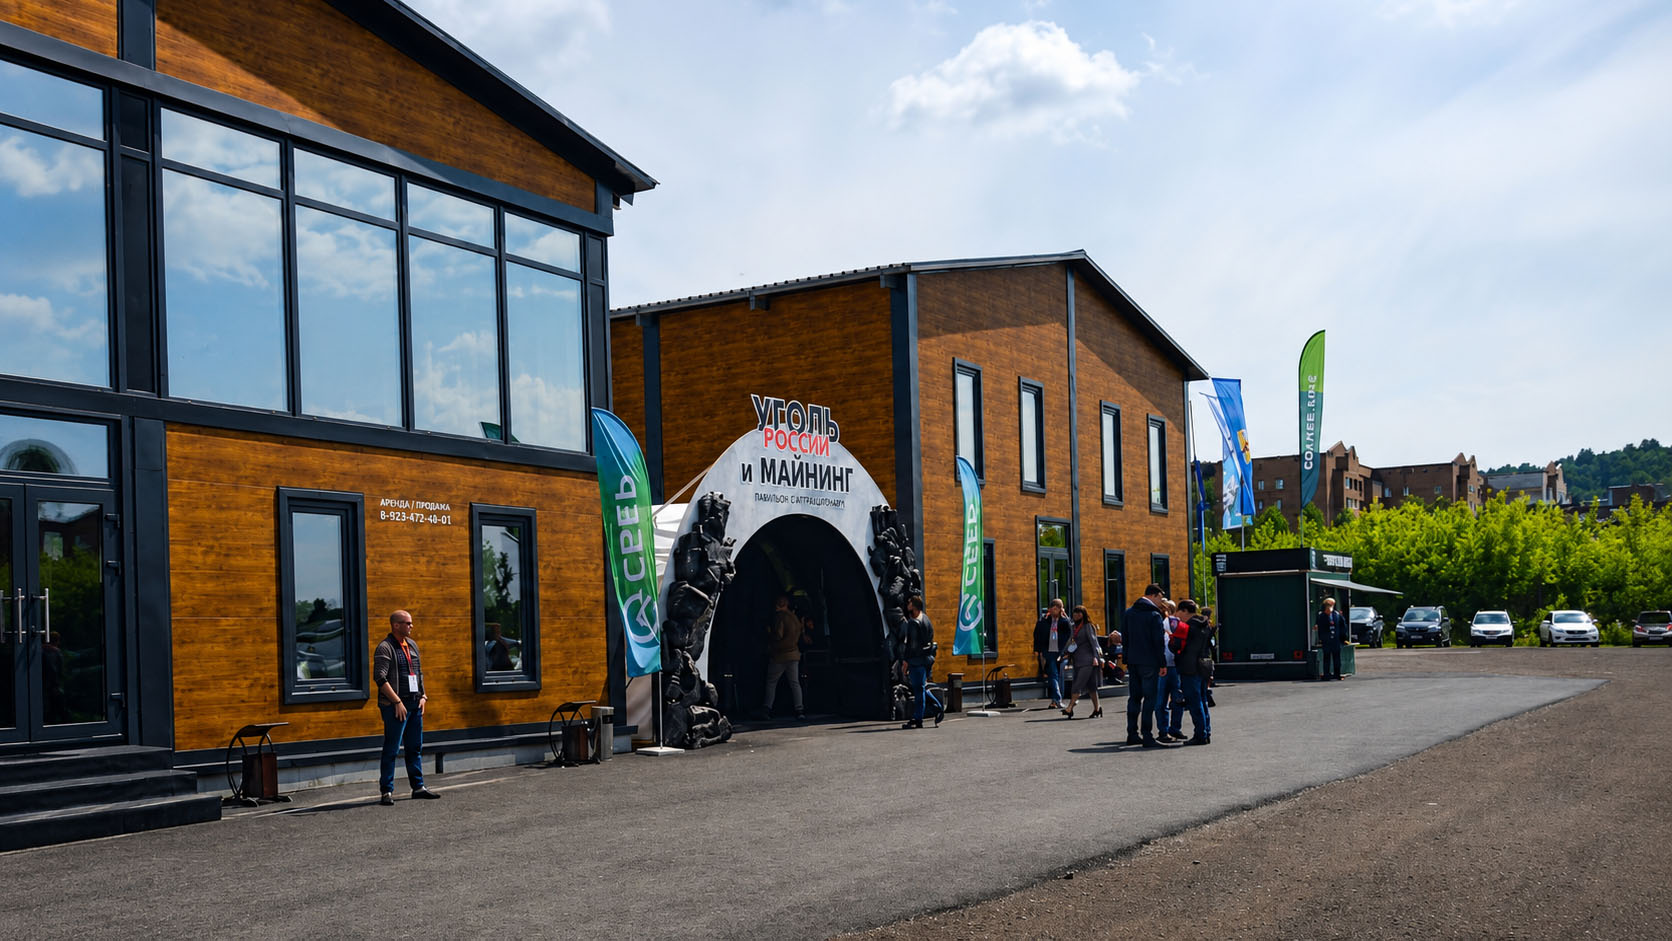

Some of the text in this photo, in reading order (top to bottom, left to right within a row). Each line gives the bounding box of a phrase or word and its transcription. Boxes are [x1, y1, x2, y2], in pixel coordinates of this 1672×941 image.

[751, 394, 840, 442] УГОЛЬ
[764, 428, 829, 457] РОССИИ
[760, 455, 853, 493] МАЙНИНГ
[380, 498, 410, 509] АРЕНДА
[415, 501, 451, 511] ПРОДАЖА
